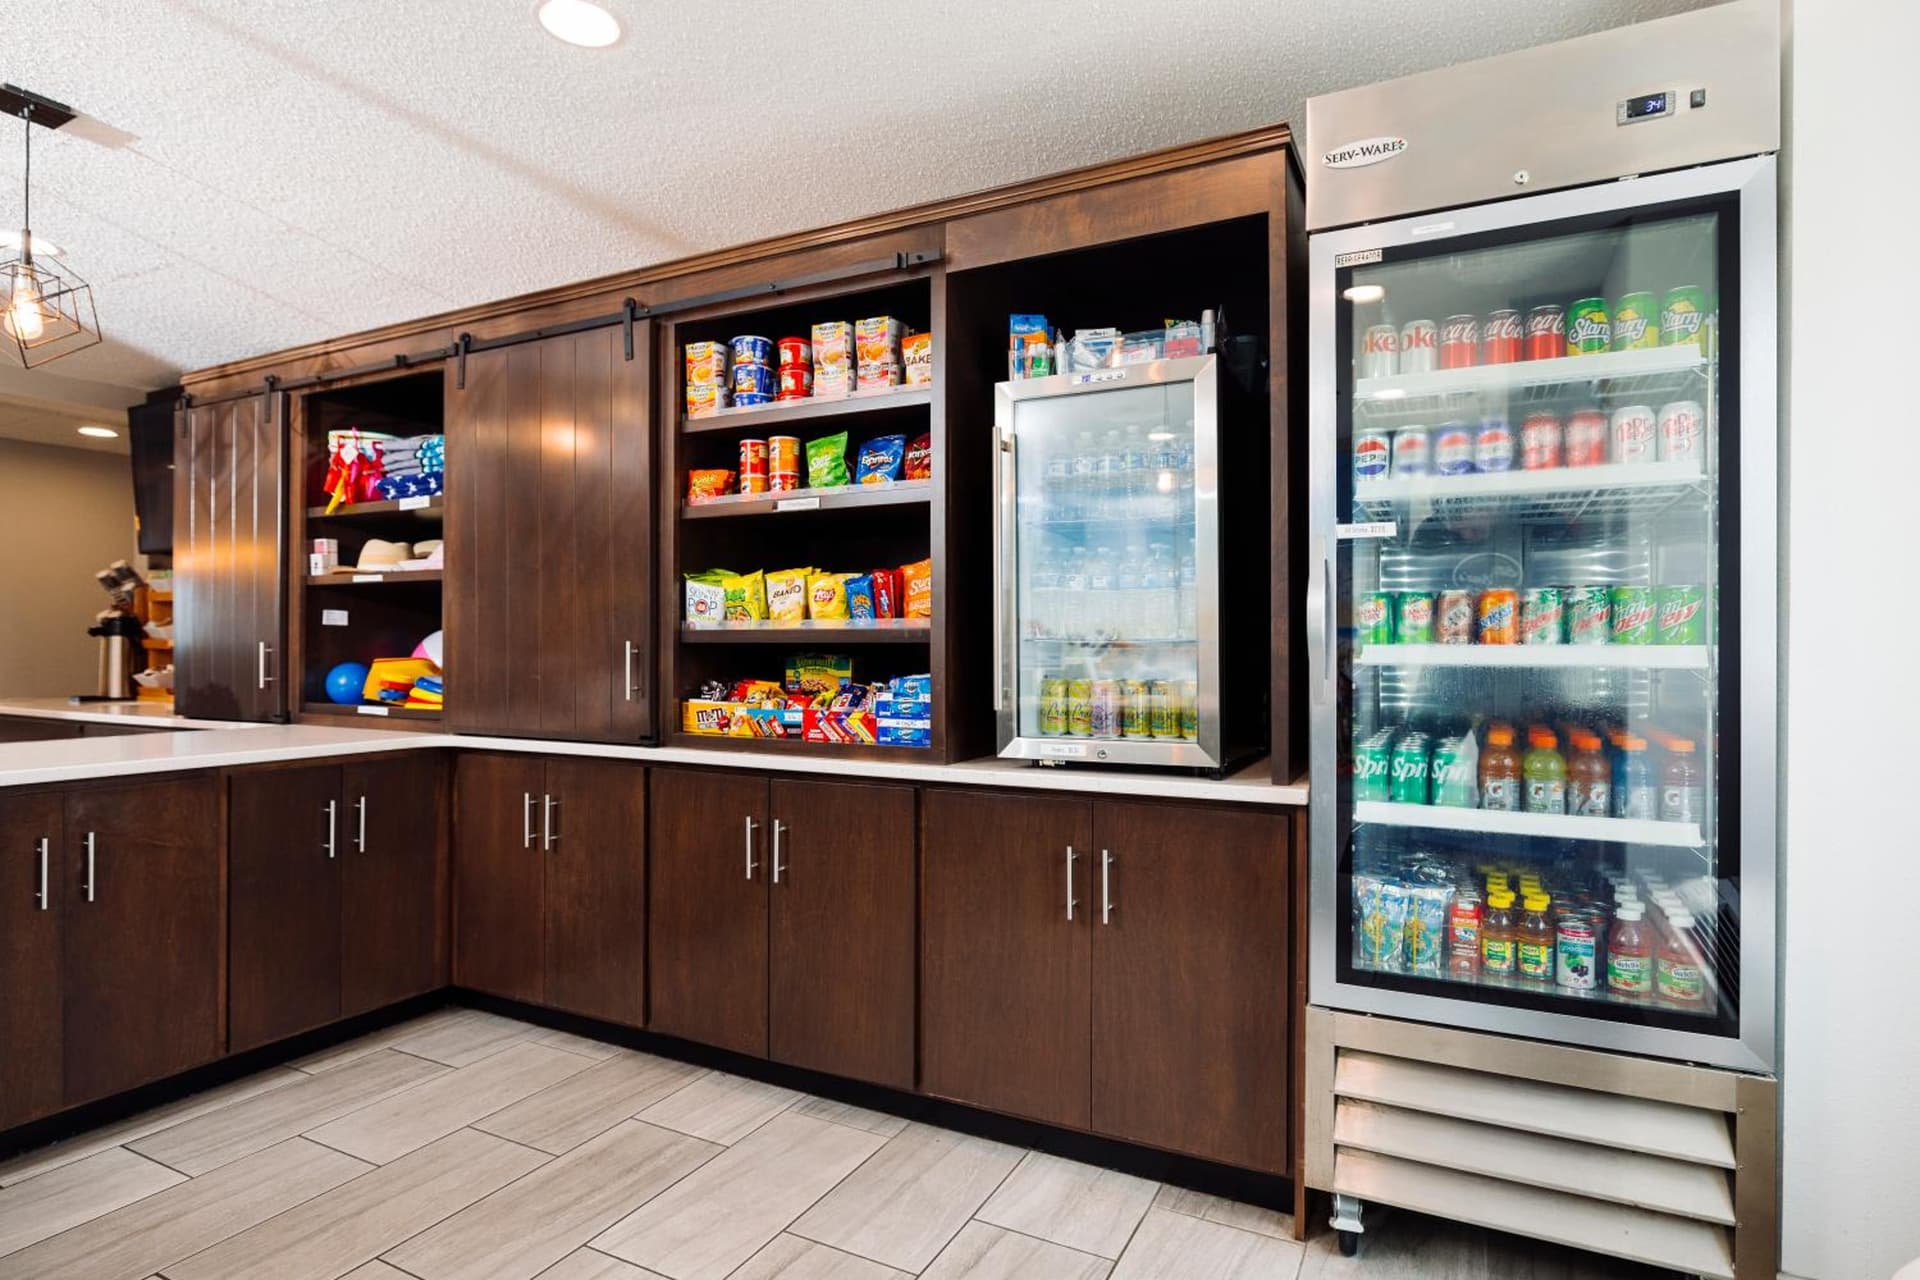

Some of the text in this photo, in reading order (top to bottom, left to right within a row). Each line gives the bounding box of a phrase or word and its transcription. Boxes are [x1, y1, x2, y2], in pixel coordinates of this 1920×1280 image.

[1324, 141, 1399, 164] SERV-WARE
[1661, 310, 1702, 333] Starry
[1355, 454, 1387, 465] PEPSI
